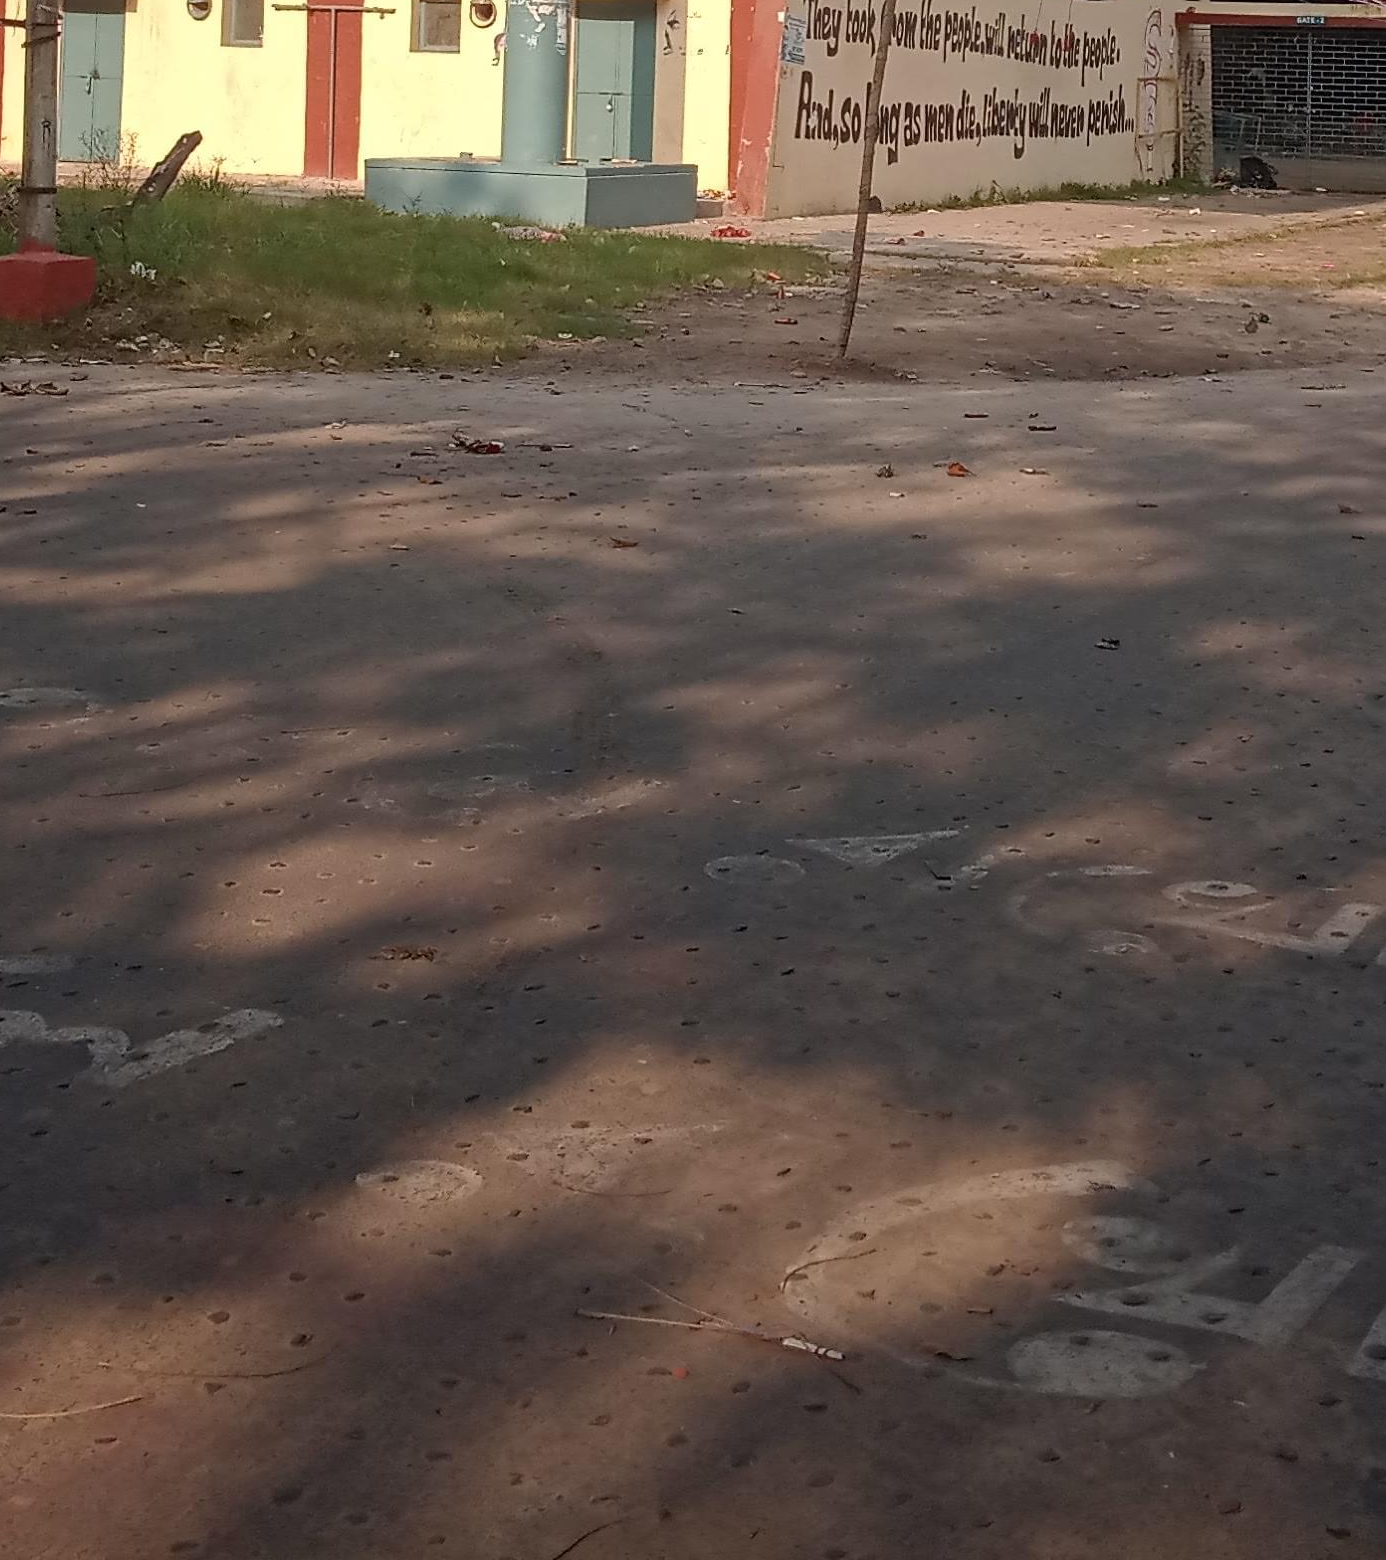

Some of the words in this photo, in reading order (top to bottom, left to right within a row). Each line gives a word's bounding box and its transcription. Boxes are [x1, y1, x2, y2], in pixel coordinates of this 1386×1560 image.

[985, 12, 1006, 58] will
[1007, 13, 1047, 66] return
[1050, 20, 1062, 69] to
[1062, 24, 1081, 69] the
[1082, 27, 1120, 87] people.
[864, 82, 901, 166] lng
[904, 102, 921, 146] as
[924, 103, 954, 142] men
[1028, 87, 1050, 138] will
[1050, 103, 1085, 138] never
[1087, 84, 1135, 147] perish...
